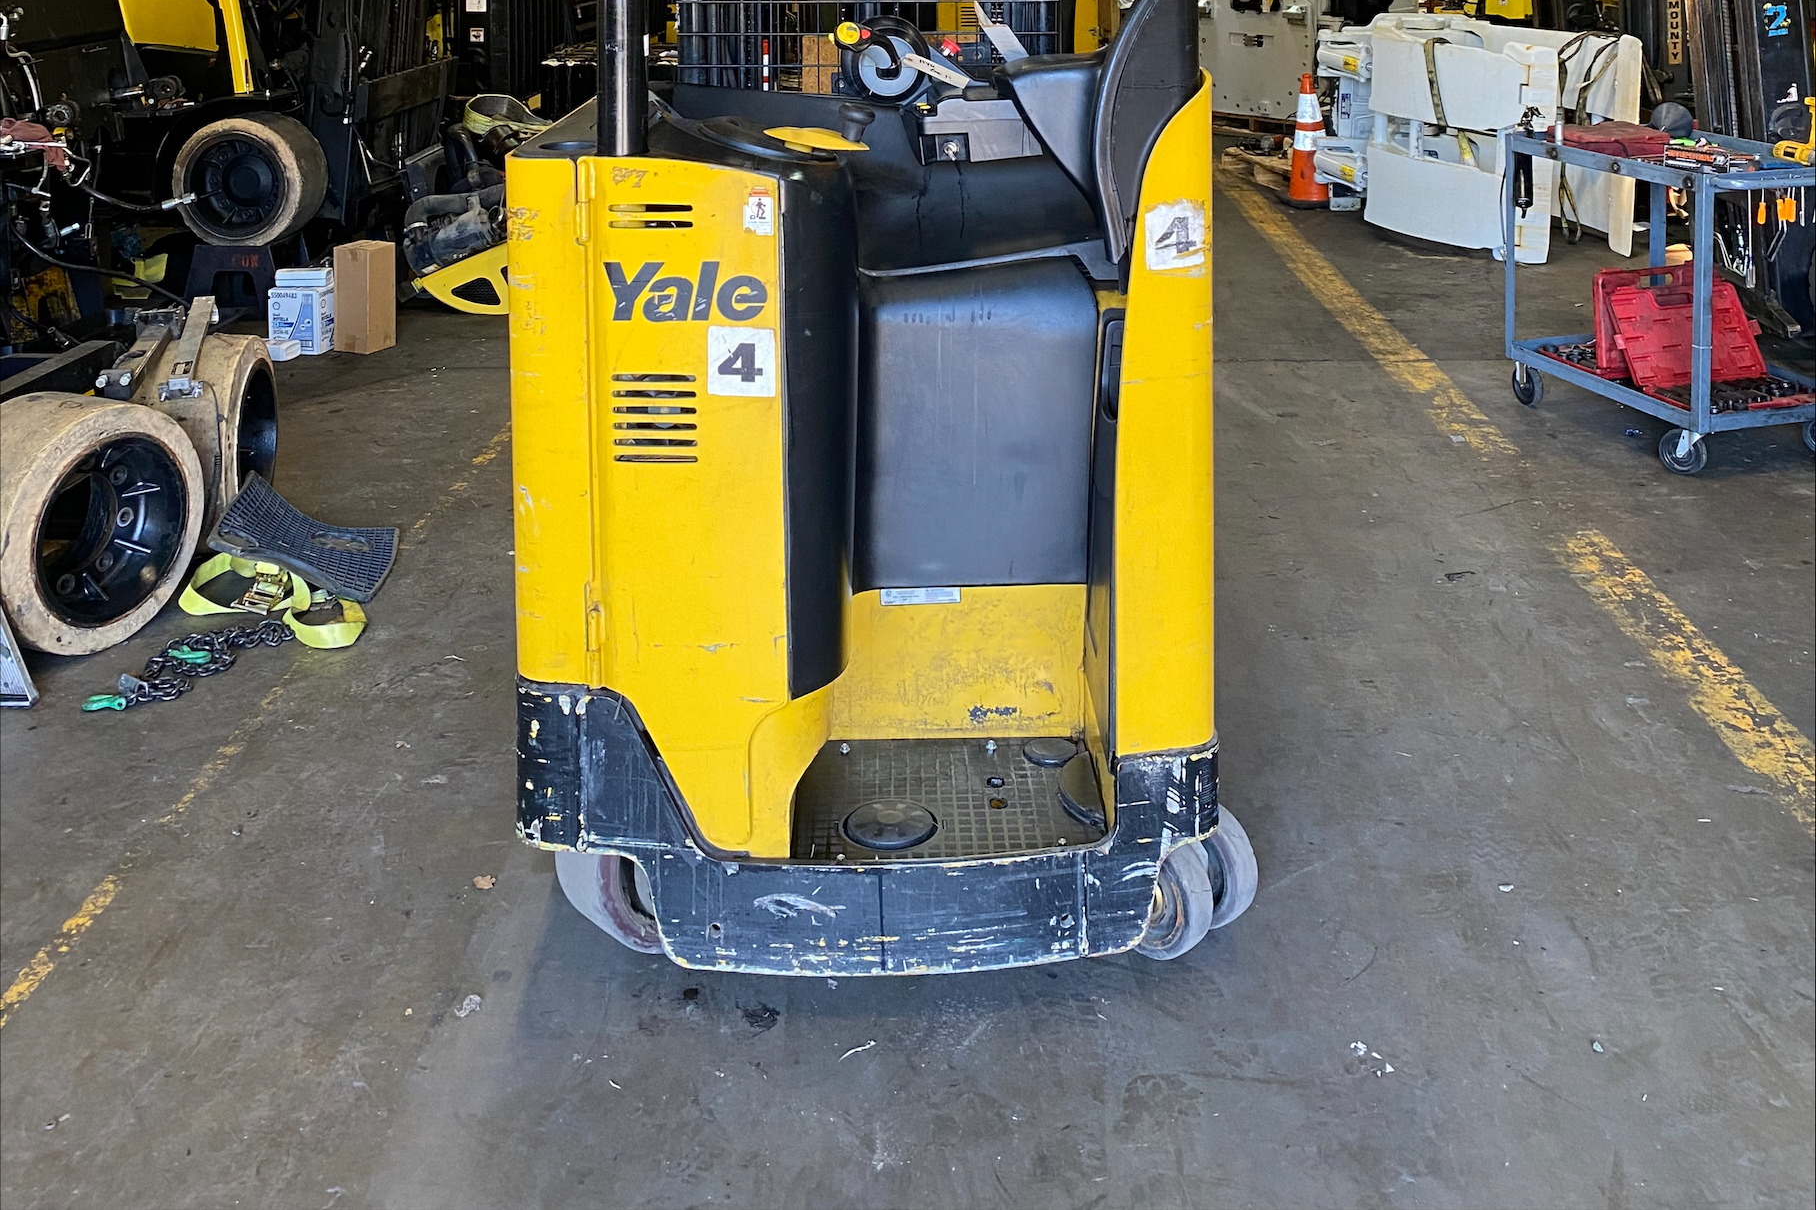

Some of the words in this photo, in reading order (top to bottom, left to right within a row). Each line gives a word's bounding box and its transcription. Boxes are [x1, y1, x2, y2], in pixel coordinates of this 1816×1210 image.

[1668, 1, 1680, 60] MOUNTY
[1154, 216, 1198, 255] 4
[602, 261, 768, 322] Yale
[717, 342, 764, 383] 4
